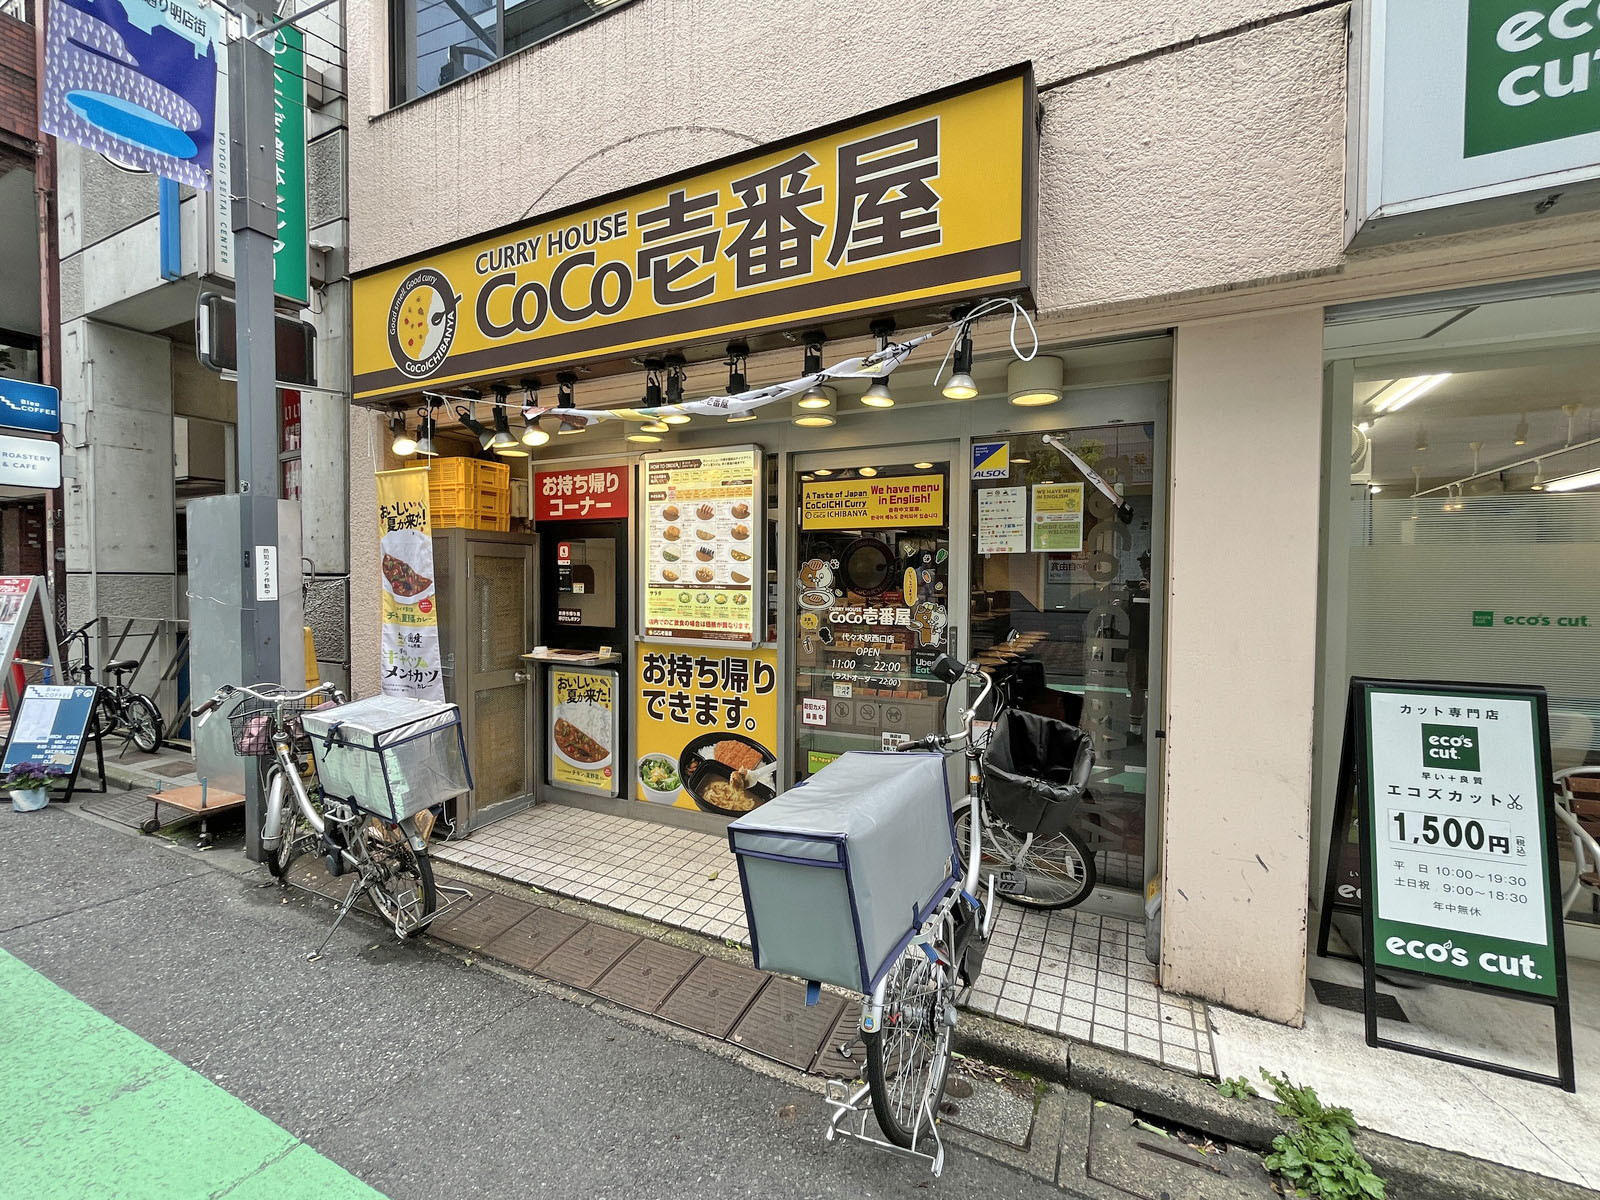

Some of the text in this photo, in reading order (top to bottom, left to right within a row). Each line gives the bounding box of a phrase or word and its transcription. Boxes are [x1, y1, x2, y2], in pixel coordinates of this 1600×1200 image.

[1496, 0, 1600, 52] ec
[1498, 48, 1600, 107] cu
[218, 131, 228, 264] YOYOGI SEITAI CENTER
[476, 210, 628, 275] CURRY HOUSE
[390, 310, 398, 335] Good
[405, 273, 422, 290] Good
[421, 274, 438, 285] curry
[405, 310, 455, 373] CoCoICHIBANYA
[20, 405, 57, 416] COFFEE
[2, 451, 51, 462] ROASTERY
[973, 469, 1007, 478] ALSOK
[542, 471, 620, 496] お持ち帰り
[870, 483, 940, 495] We have menu
[812, 491, 834, 499] Taste
[835, 490, 843, 498] of
[844, 490, 868, 498] Japan
[878, 493, 931, 505] in English!
[380, 501, 413, 520] おいしい
[549, 496, 612, 517] コーナー
[805, 499, 867, 509] CoCoICHI Curry
[827, 509, 868, 518] ICHIBANYA
[842, 633, 895, 644] 代々木駅西口店
[855, 647, 881, 657] OPEN
[831, 658, 856, 669] 11:00
[873, 660, 901, 672] 22:00
[915, 666, 931, 674] Eat
[642, 652, 777, 696] お持ち帰り
[557, 675, 594, 689] おいしい
[878, 678, 901, 687] 22:00)
[566, 687, 611, 707] 夏が来た!
[641, 688, 758, 732] できます。
[804, 703, 826, 711] 防犯カメラ
[1399, 704, 1500, 721] カット専門店
[1428, 734, 1474, 748] eco's
[1429, 746, 1461, 761] cut.
[1387, 784, 1503, 807] エコズカット
[1393, 811, 1511, 855] 1,500円
[1394, 876, 1431, 891] 土日祝
[1432, 901, 1483, 917] 年中無休
[1385, 936, 1544, 980] eco's cut.
